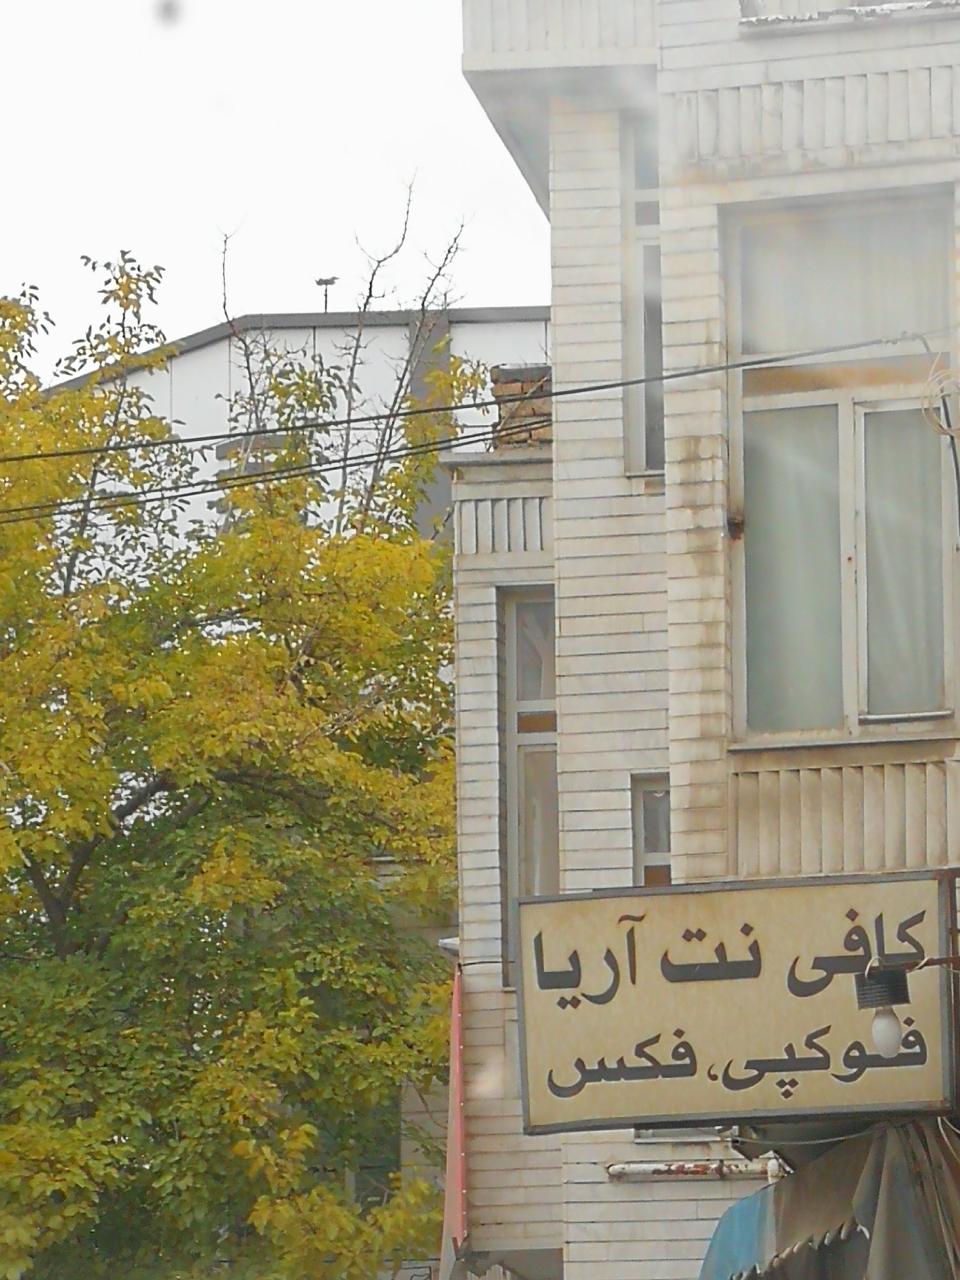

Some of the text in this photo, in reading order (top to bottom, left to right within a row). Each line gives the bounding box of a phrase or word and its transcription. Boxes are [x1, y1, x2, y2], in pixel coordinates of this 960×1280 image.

[532, 907, 928, 1010] کافی نت آریا
[546, 1014, 929, 1100] فوکپی، فکس
